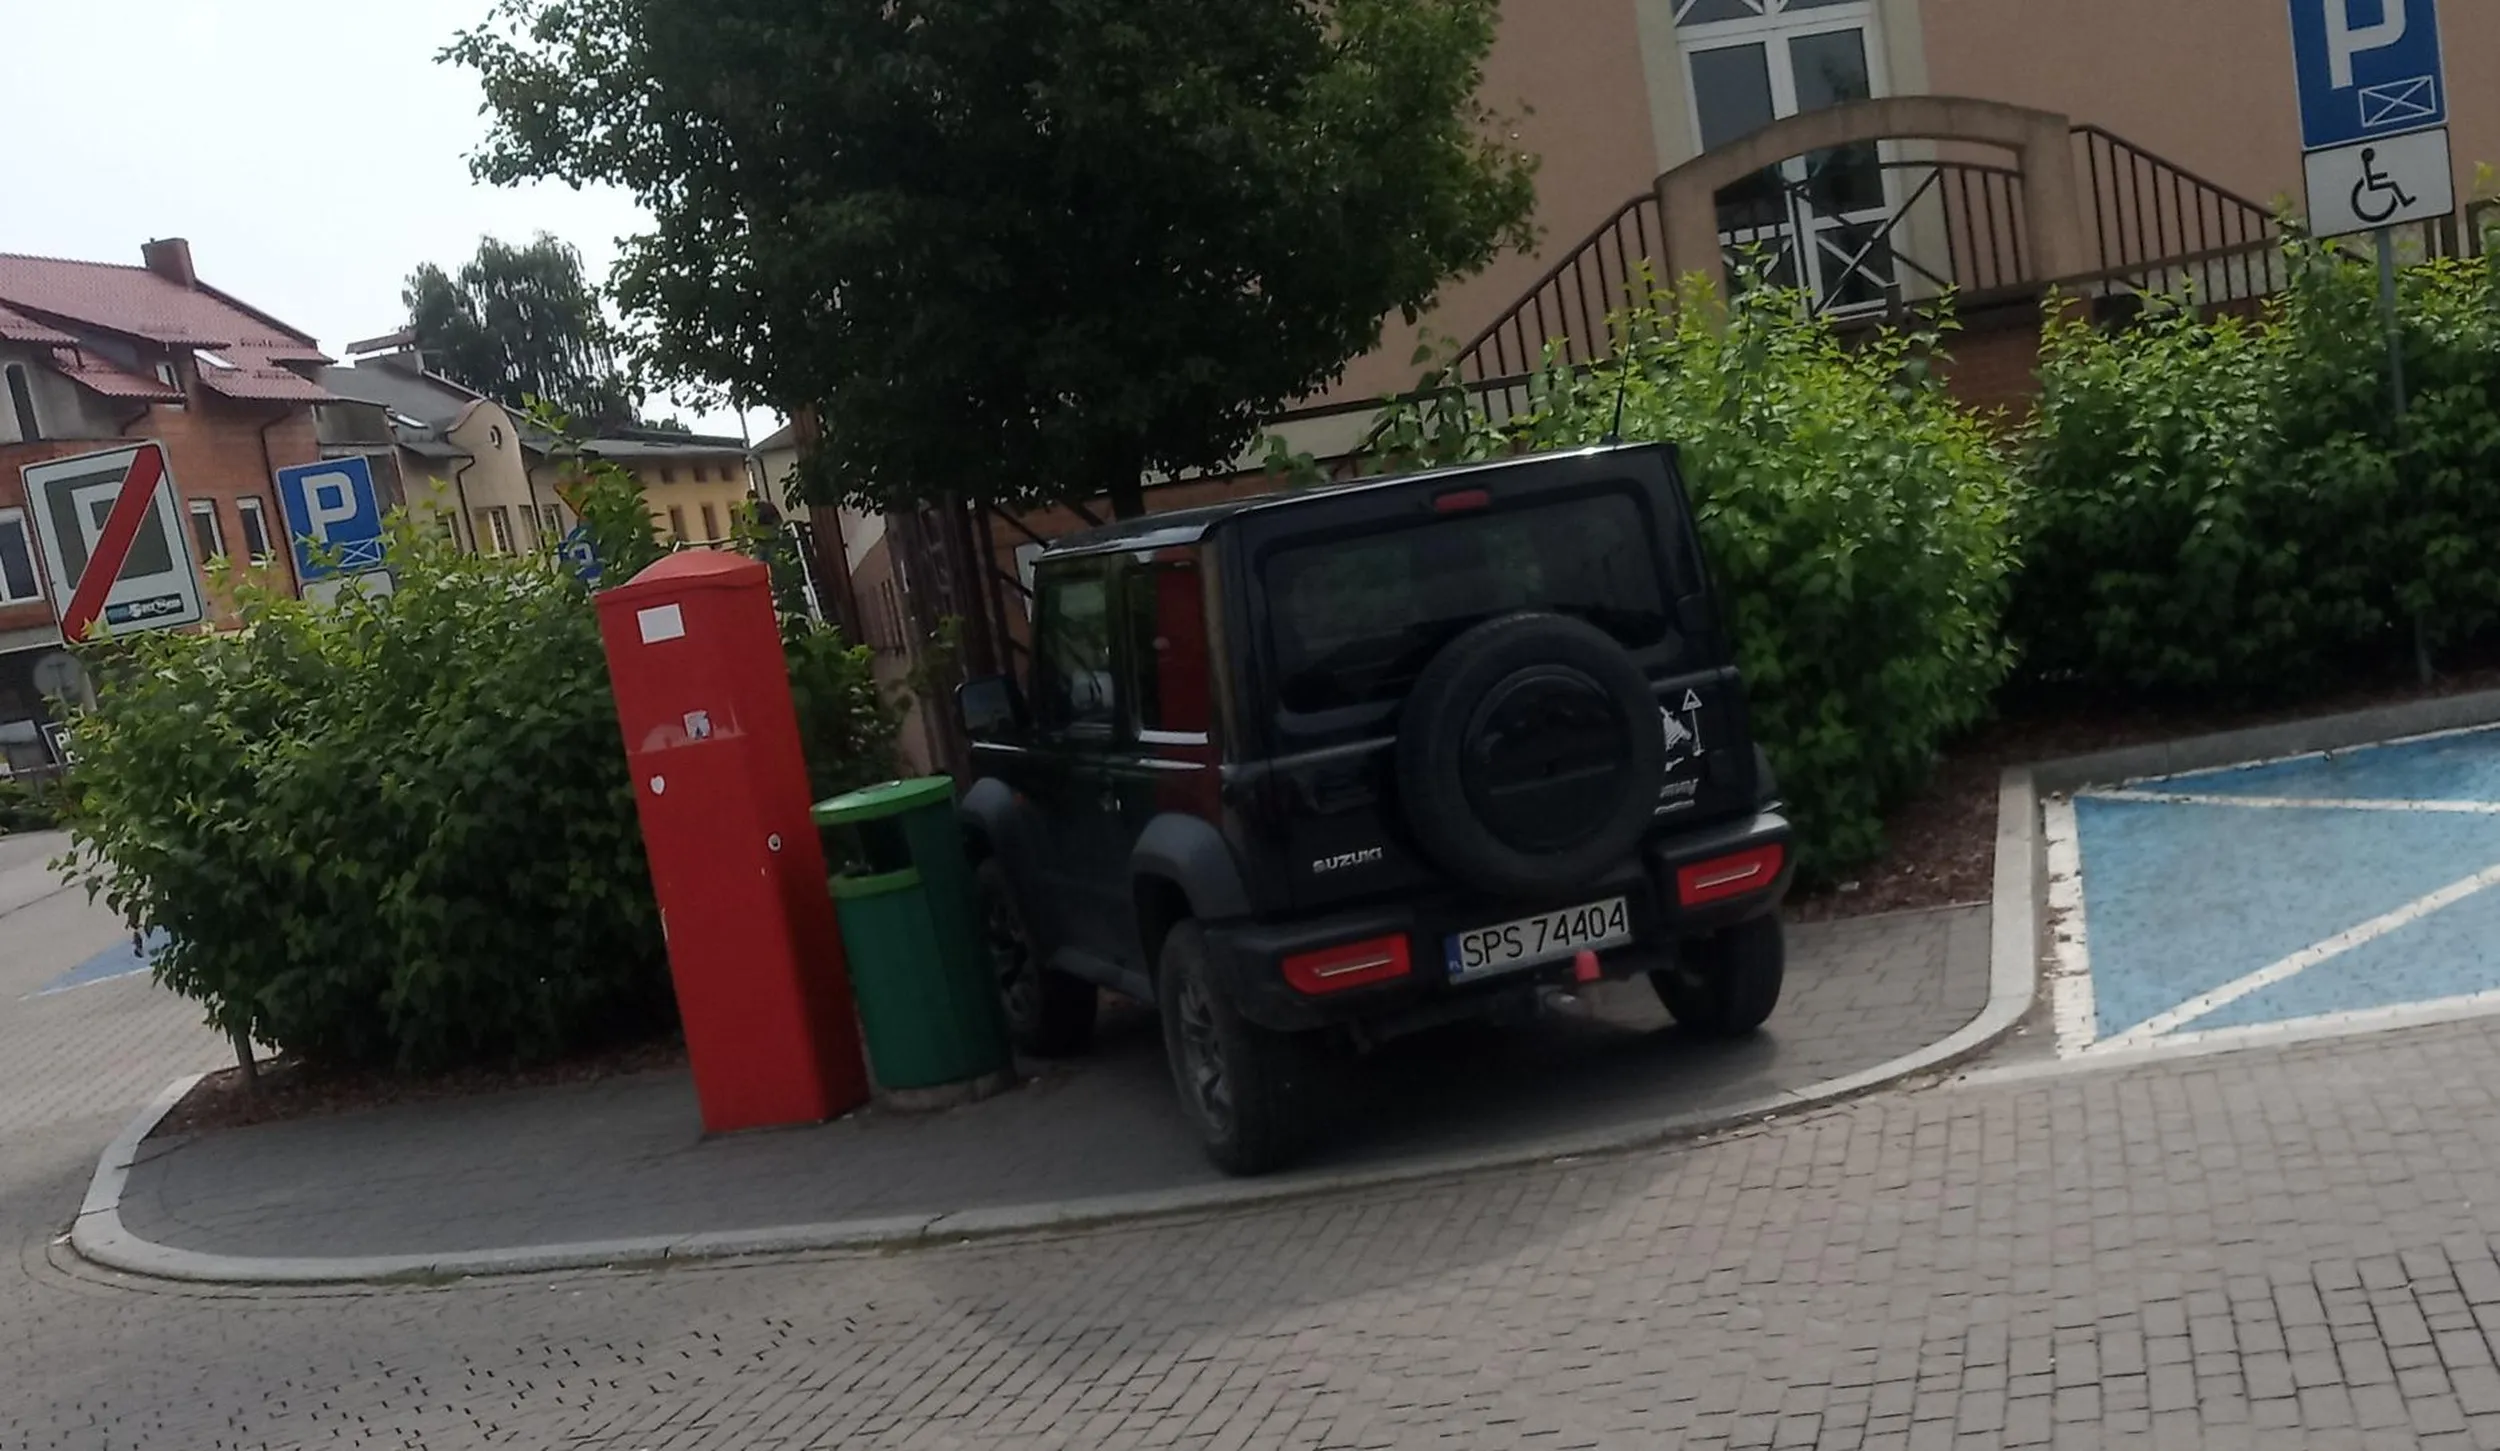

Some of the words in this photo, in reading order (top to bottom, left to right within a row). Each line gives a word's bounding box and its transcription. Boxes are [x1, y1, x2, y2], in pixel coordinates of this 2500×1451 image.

[2324, 0, 2406, 89] P
[301, 471, 357, 544] P
[1312, 846, 1383, 874] SUZUKI
[1463, 925, 1524, 968] SPS
[1532, 901, 1626, 953] 74404
